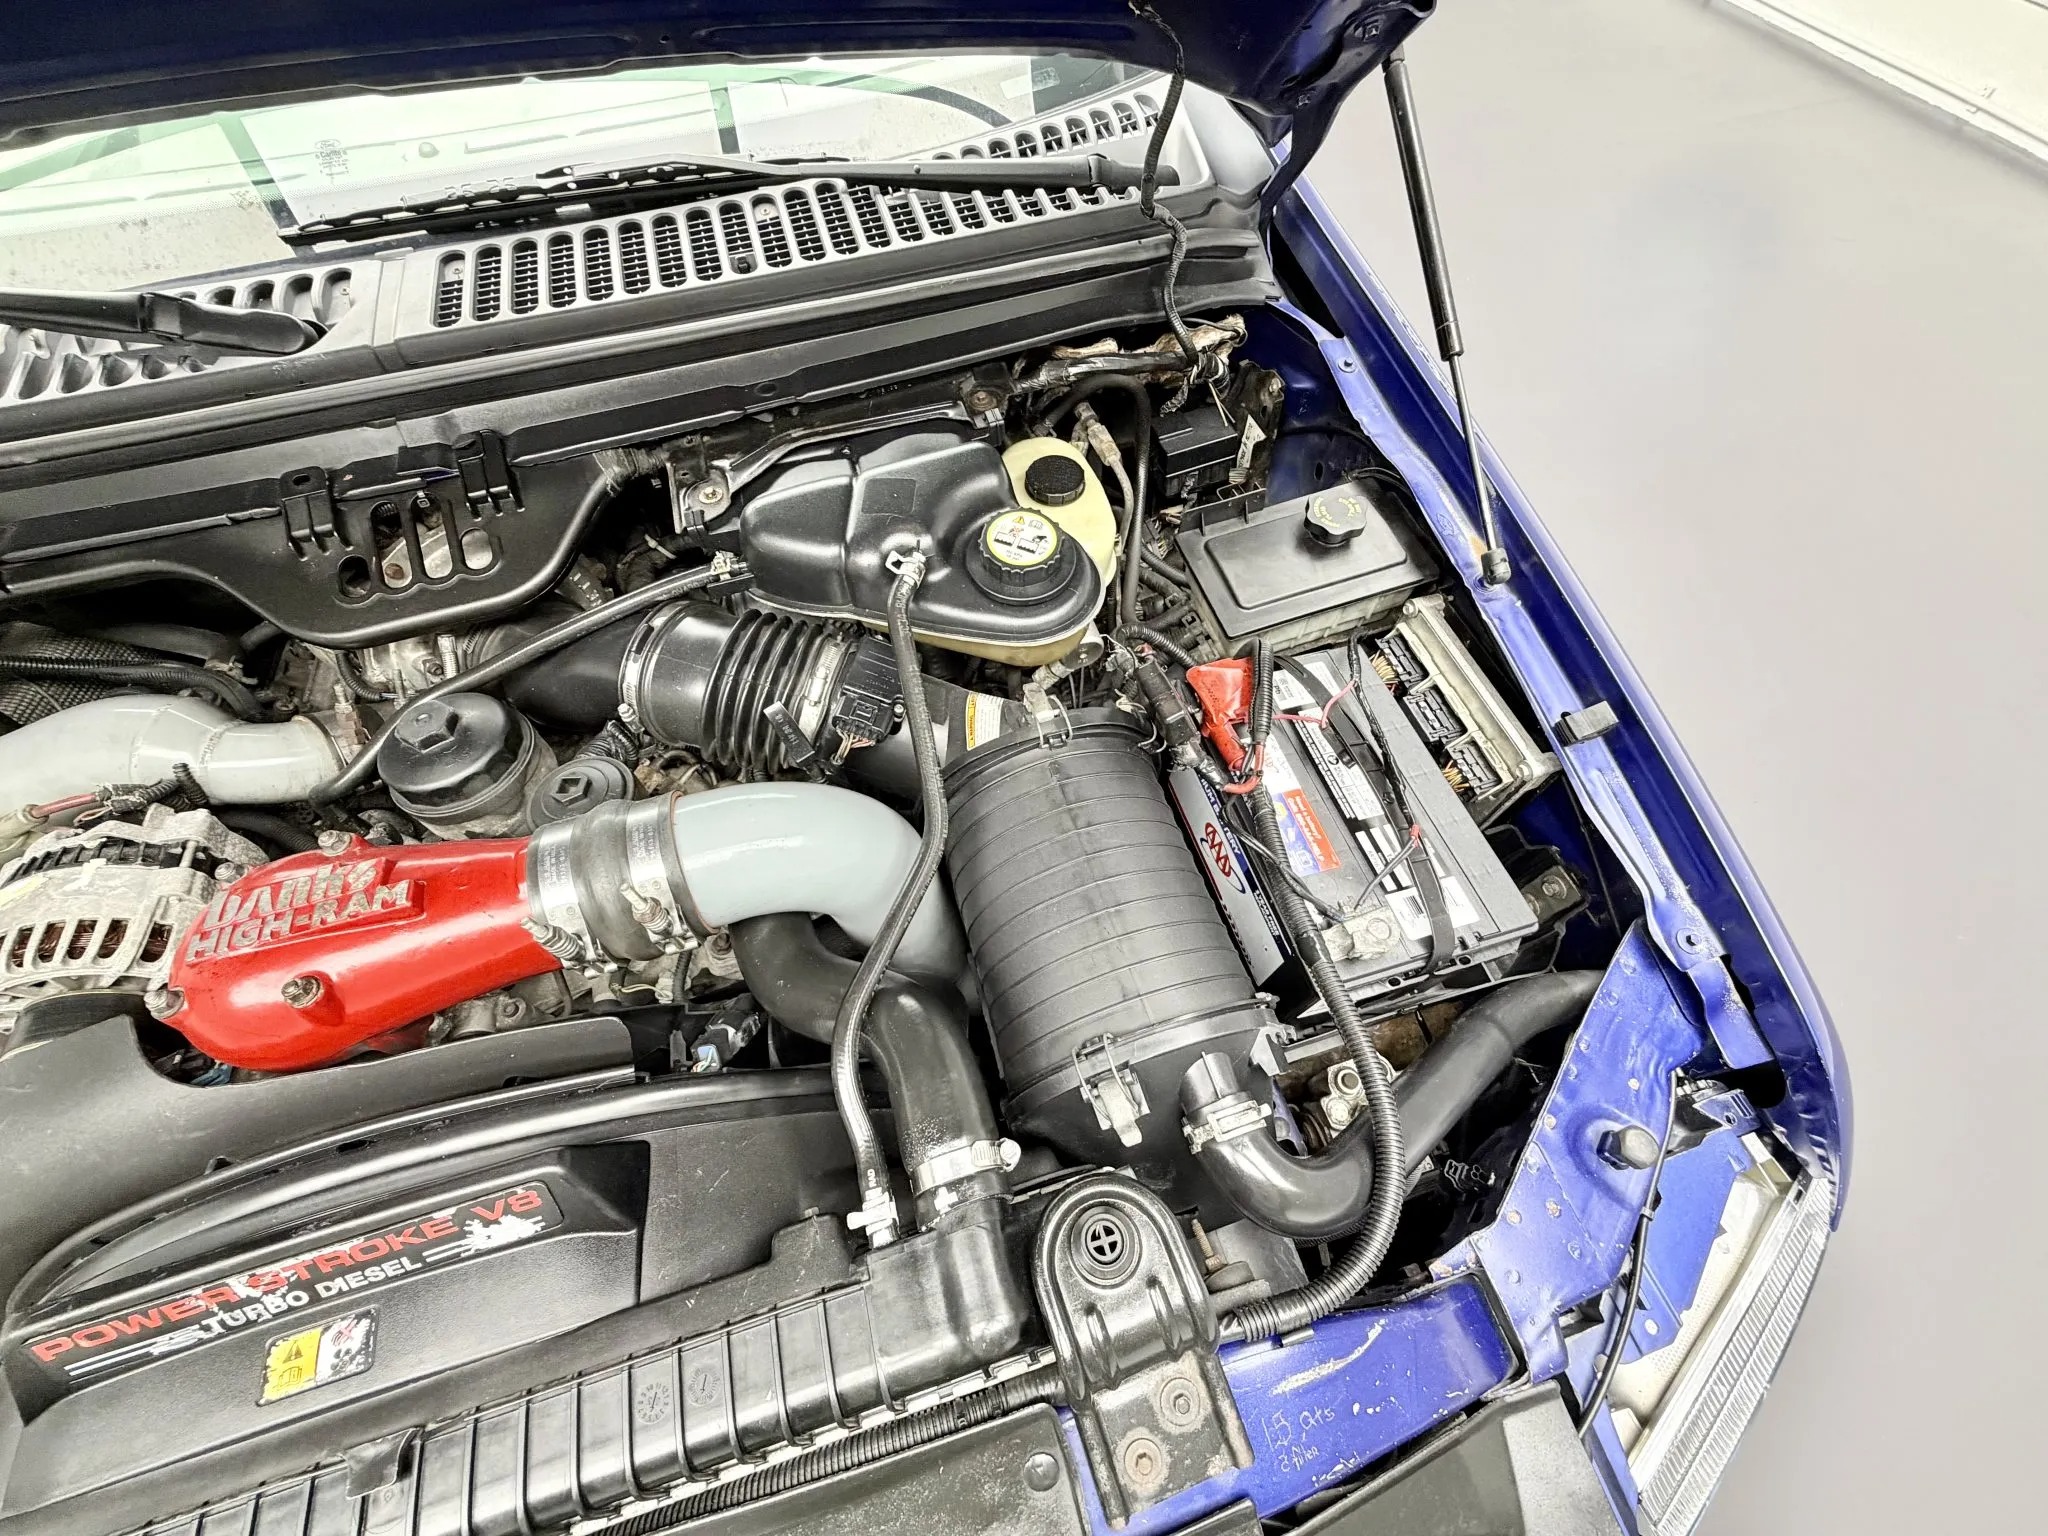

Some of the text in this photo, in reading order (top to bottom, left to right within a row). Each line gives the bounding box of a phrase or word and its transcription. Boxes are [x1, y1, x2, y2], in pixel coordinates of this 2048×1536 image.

[1204, 822, 1232, 877] AAA
[186, 879, 410, 962] HIGH-RAM
[470, 1189, 543, 1221] V8
[202, 1256, 423, 1336] TURBO DIESEL
[1261, 1409, 1292, 1453] 15
